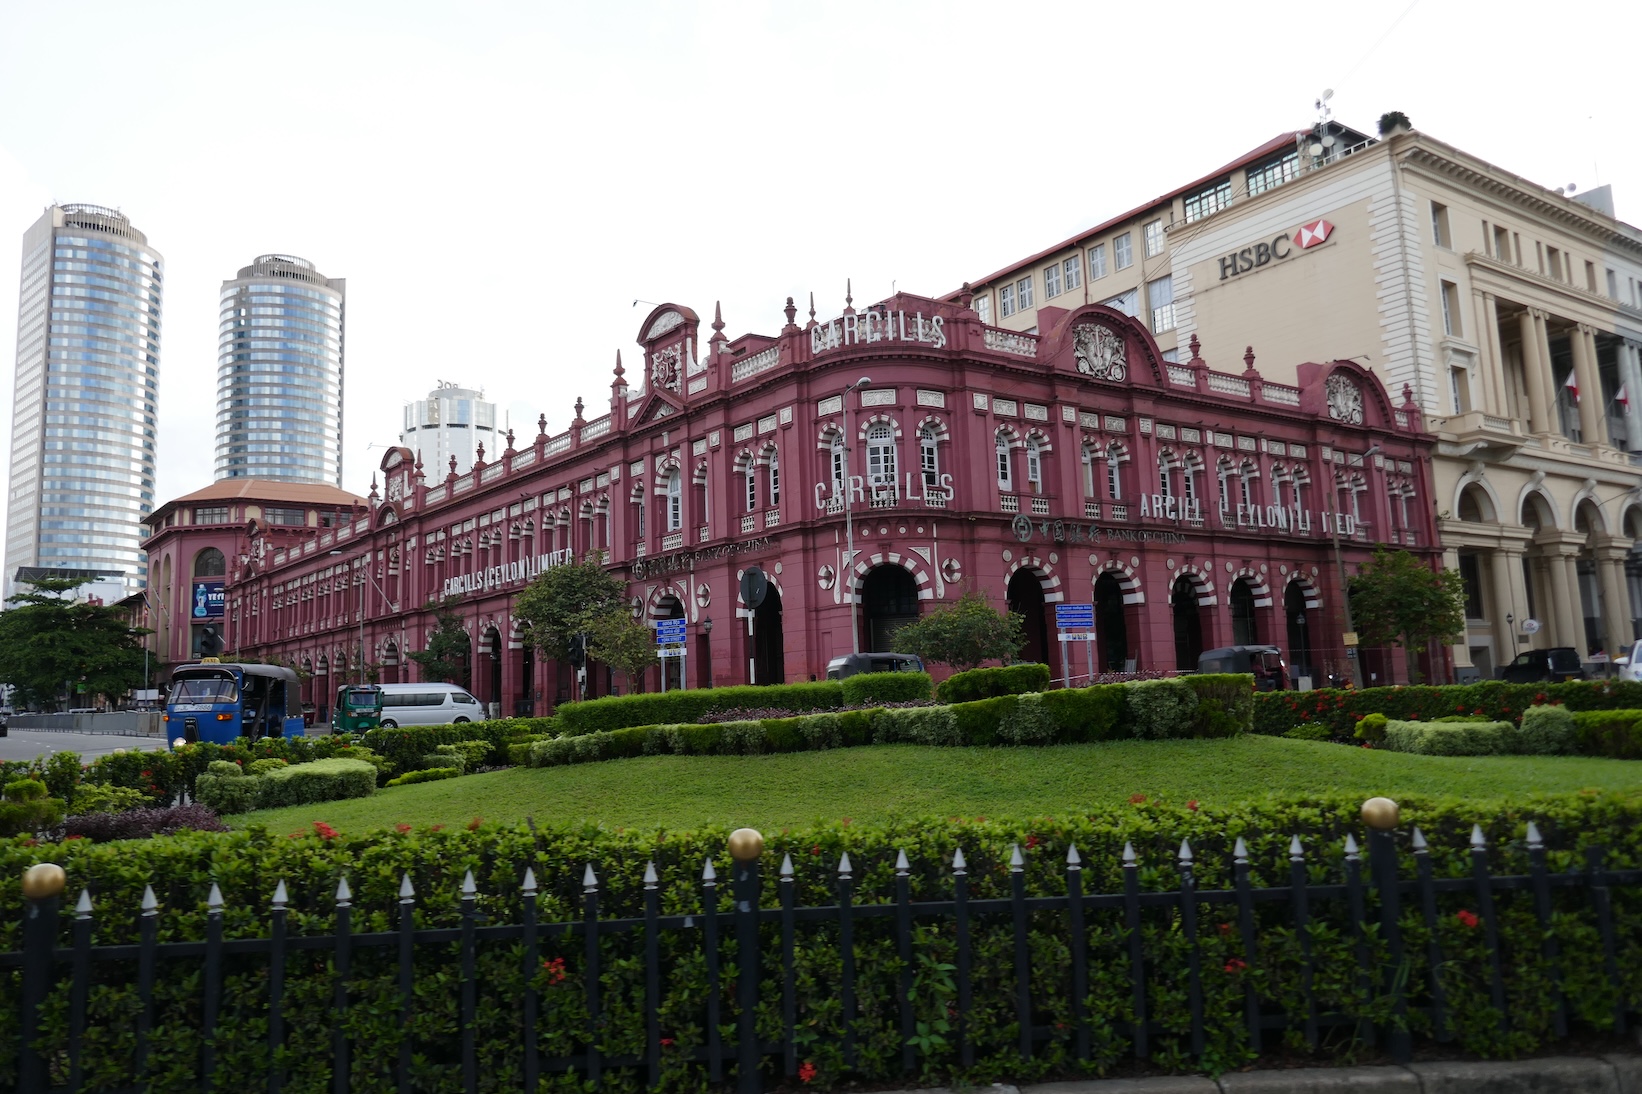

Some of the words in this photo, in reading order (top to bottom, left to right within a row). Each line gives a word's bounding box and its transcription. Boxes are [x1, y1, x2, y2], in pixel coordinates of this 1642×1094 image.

[1217, 233, 1291, 281] HSBC
[811, 310, 947, 355] CARGILLS
[814, 472, 955, 510] CARGILLS
[1106, 528, 1137, 542] BANK
[1138, 530, 1152, 543] OF
[1153, 531, 1187, 544] CHINA
[444, 571, 483, 597] CARGILLS
[484, 555, 530, 591] (CEYLON)
